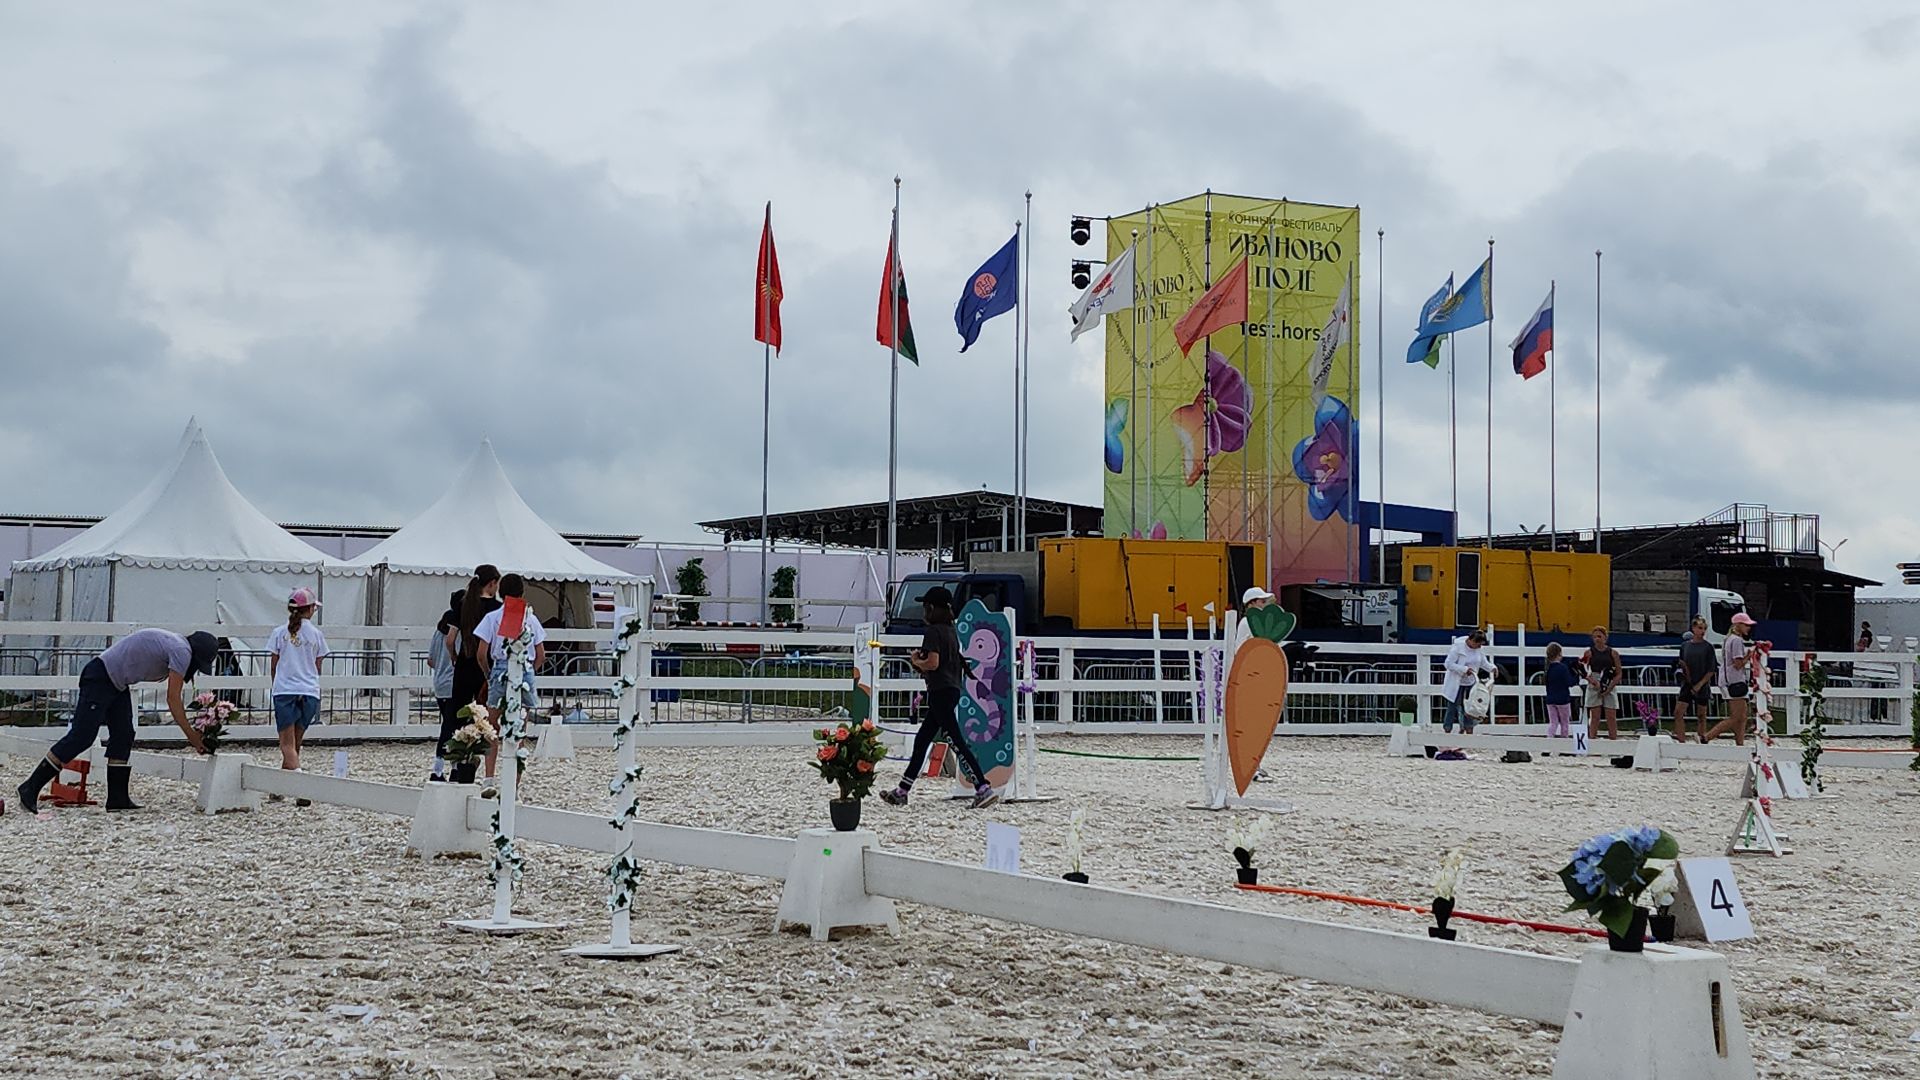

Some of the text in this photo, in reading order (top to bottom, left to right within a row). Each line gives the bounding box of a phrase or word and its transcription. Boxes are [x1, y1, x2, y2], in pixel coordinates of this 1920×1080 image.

[1281, 217, 1342, 233] ФЕСТИВАЛЬ
[1229, 231, 1342, 264] ИВАНОВО
[1255, 264, 1316, 293] ПОЛЕ
[1240, 319, 1322, 341] fest.hors
[1576, 732, 1587, 751] K
[1710, 878, 1735, 918] 4
